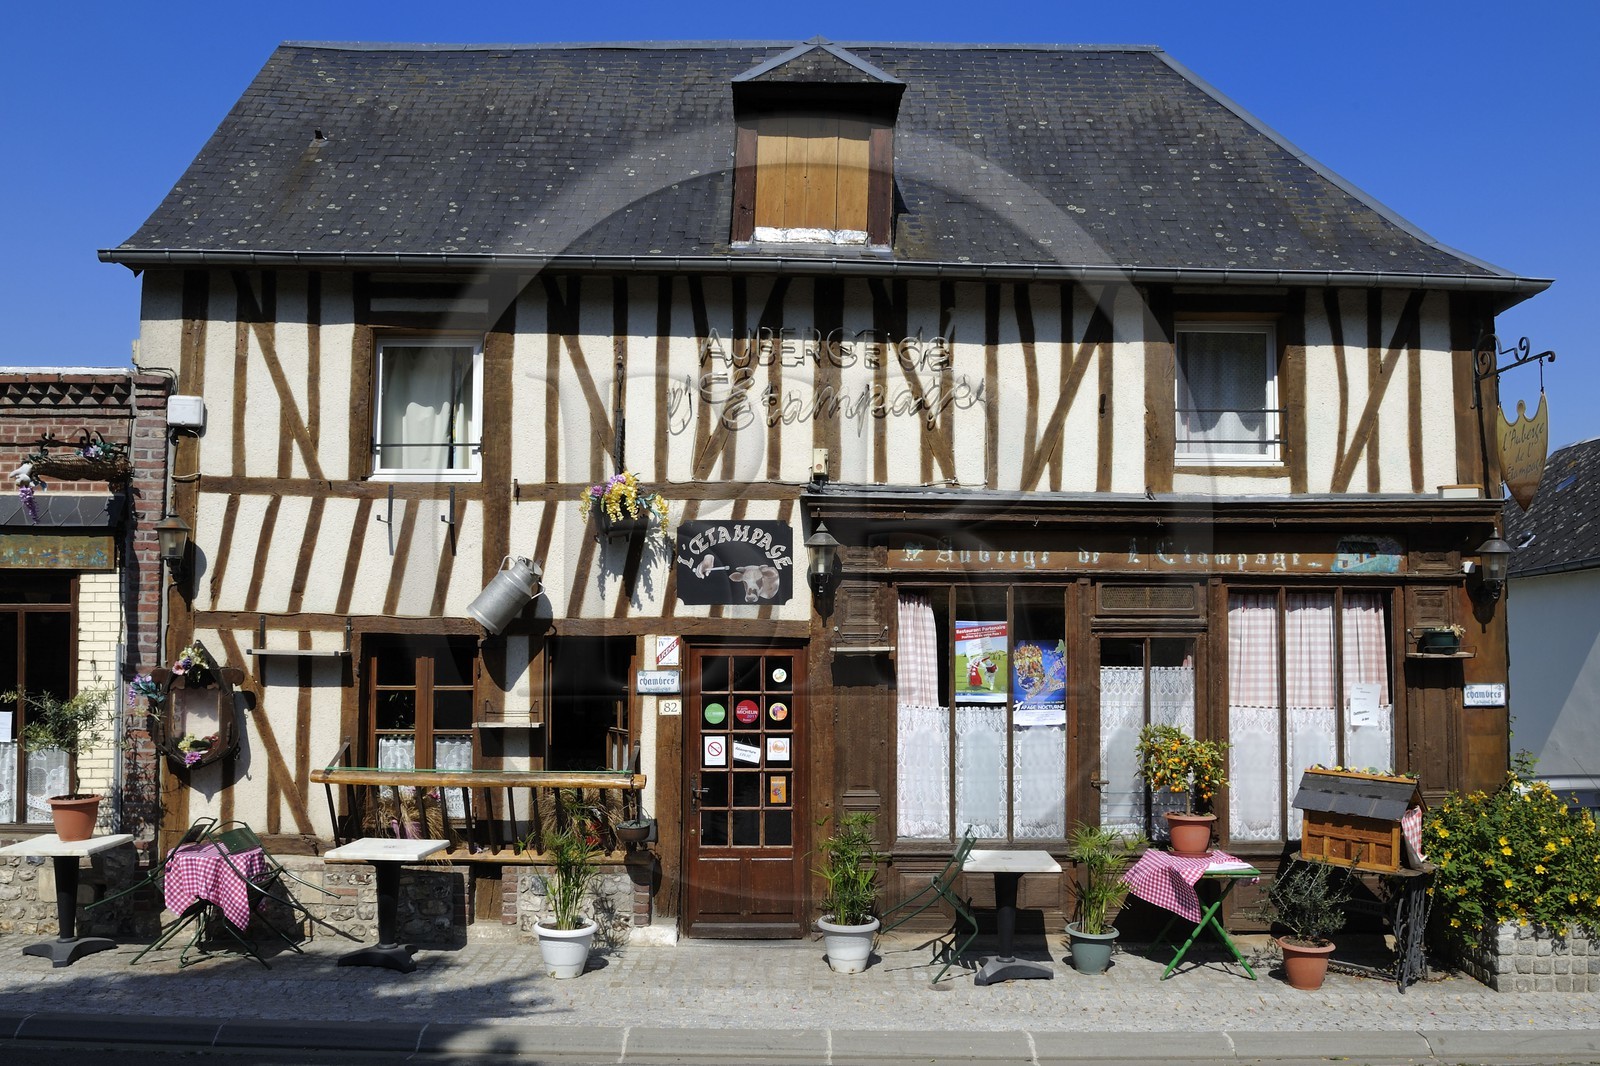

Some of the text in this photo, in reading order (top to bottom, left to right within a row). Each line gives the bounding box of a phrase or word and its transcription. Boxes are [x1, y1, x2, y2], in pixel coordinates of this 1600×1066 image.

[698, 326, 886, 366] AUBERGE
[639, 677, 675, 686] chambres
[1466, 690, 1502, 699] chambres
[663, 702, 678, 712] 82
